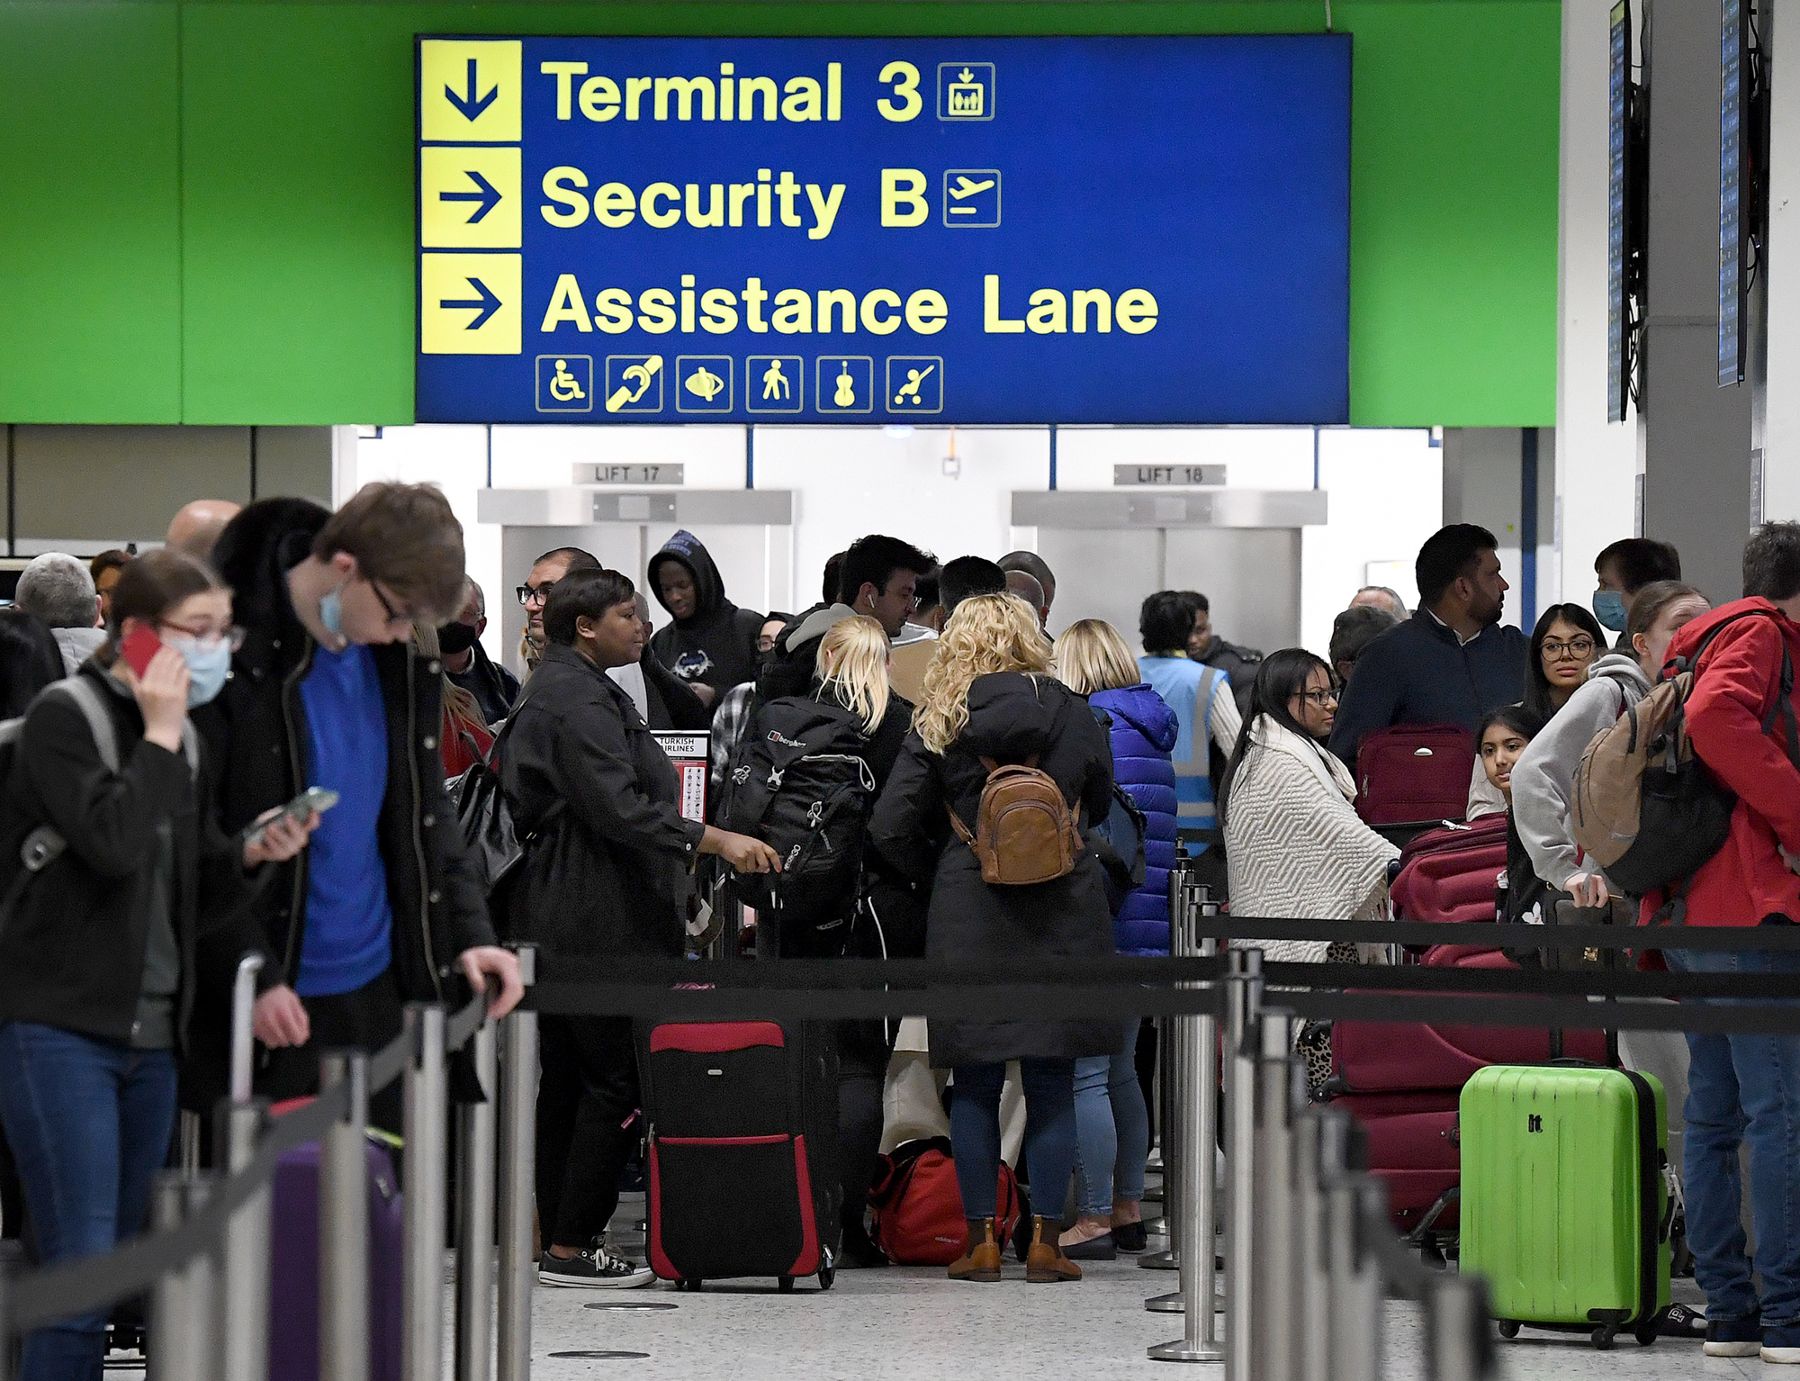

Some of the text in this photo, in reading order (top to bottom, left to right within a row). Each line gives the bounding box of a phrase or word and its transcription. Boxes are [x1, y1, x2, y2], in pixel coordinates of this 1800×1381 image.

[541, 61, 923, 123] Terminal 3
[541, 166, 929, 240] Security B
[541, 273, 1159, 335] Assistance Lane
[595, 466, 659, 481] LIFT 17
[1138, 467, 1203, 482] LIFT 18
[660, 737, 695, 745] TURKISH
[779, 735, 807, 748] bergh
[664, 745, 695, 753] IRLINES
